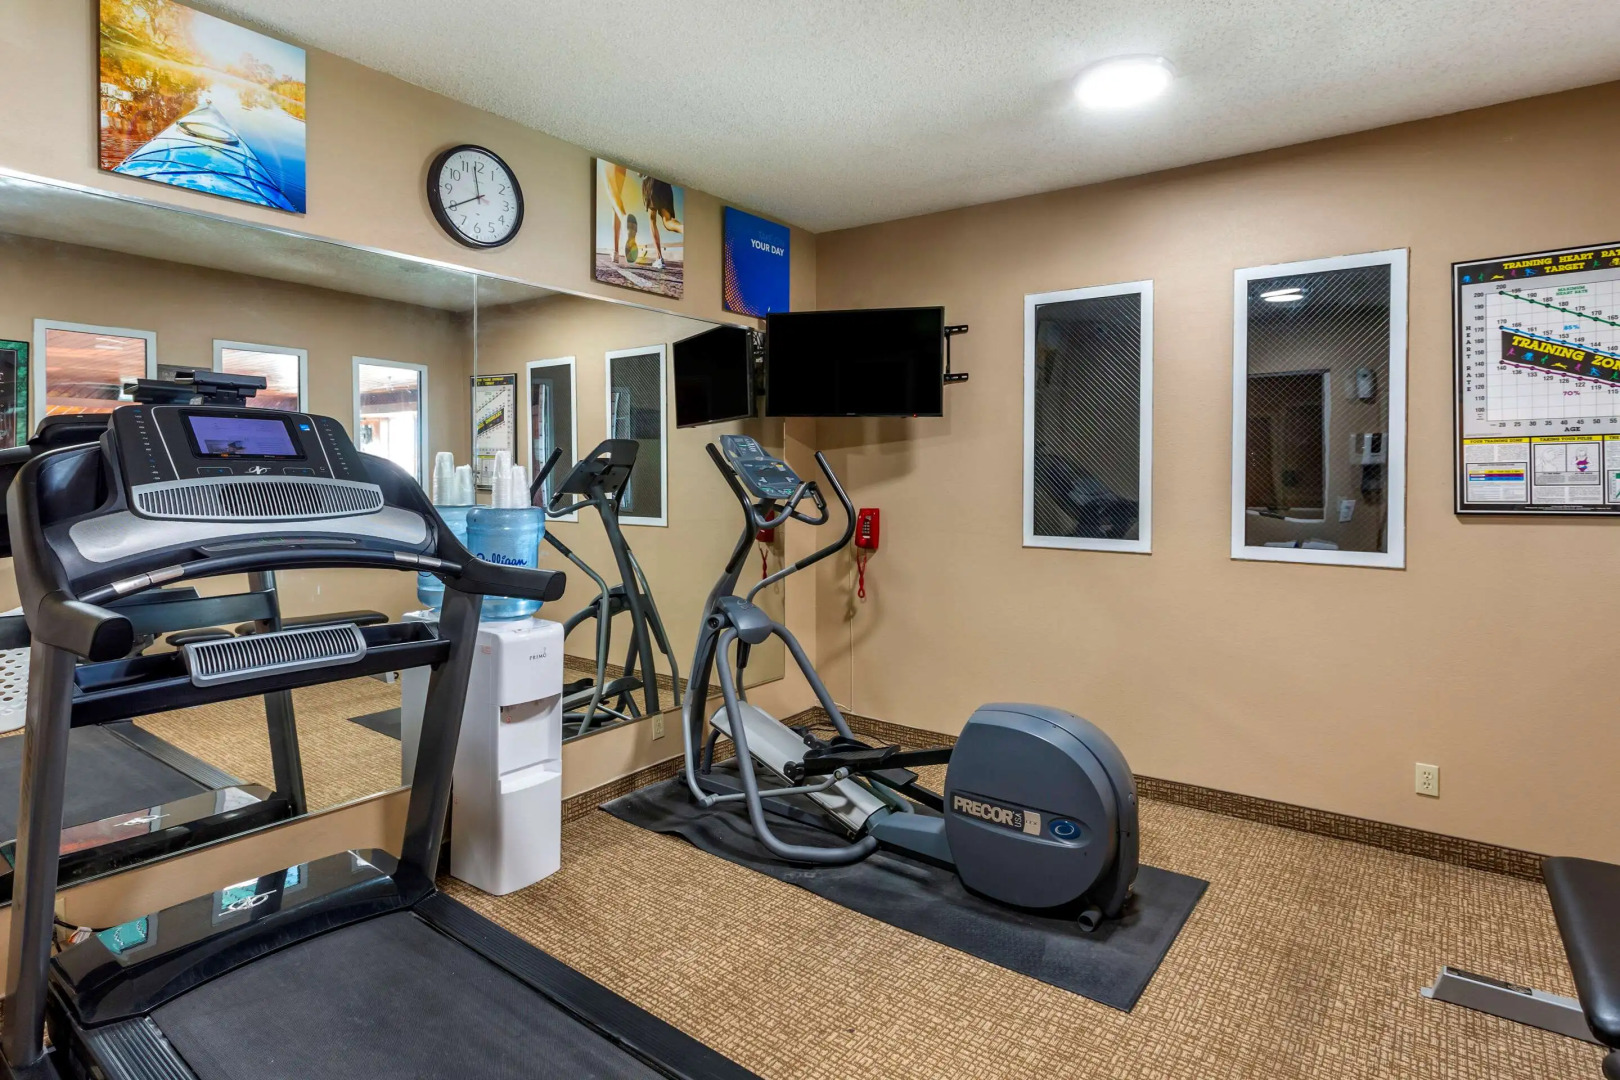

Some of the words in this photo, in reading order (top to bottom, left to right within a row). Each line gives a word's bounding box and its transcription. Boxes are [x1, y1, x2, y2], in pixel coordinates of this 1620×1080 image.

[462, 161, 468, 173] 11
[474, 161, 484, 174] 12
[450, 169, 461, 181] 10
[445, 183, 453, 194] 9
[499, 184, 505, 195] 2
[450, 200, 457, 211] 8
[503, 201, 510, 212] 3
[460, 214, 468, 225] 7
[498, 215, 505, 225] 4
[473, 222, 481, 234] 6
[488, 222, 495, 233] 5
[751, 239, 770, 252] YOUR
[771, 246, 784, 256] DAY
[1503, 258, 1552, 269] TRAINING
[1559, 253, 1594, 263] HEART
[1544, 262, 1585, 273] TARGET
[1512, 336, 1585, 361] TRAINING
[529, 653, 547, 661] PRIMO
[954, 795, 1014, 826] PRECOR
[1014, 813, 1022, 828] USA
